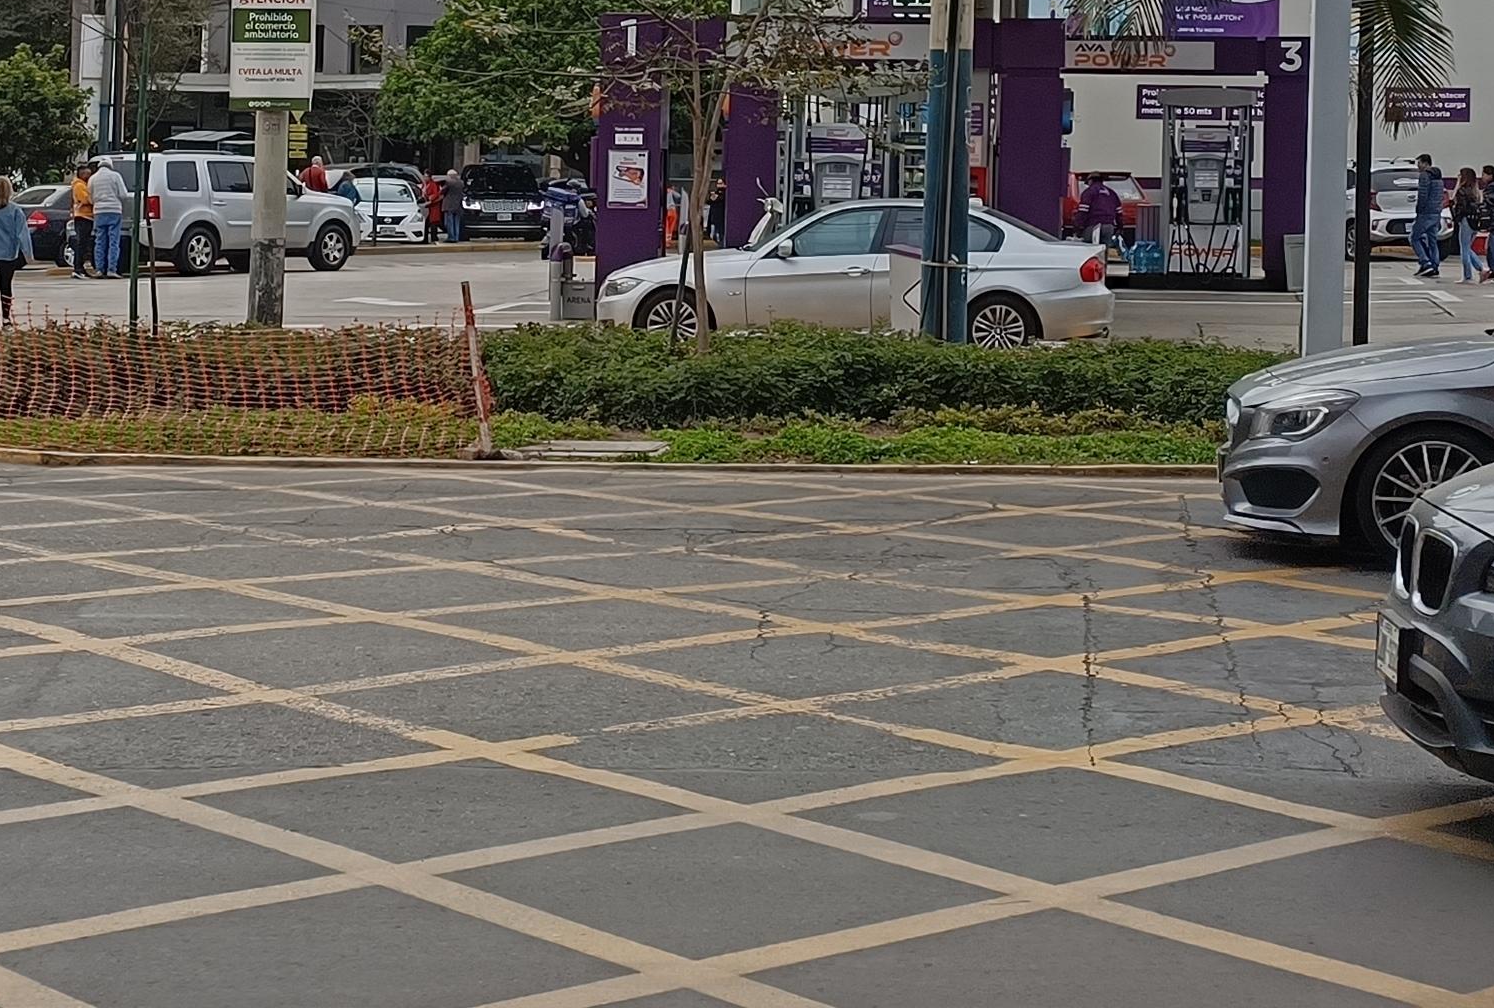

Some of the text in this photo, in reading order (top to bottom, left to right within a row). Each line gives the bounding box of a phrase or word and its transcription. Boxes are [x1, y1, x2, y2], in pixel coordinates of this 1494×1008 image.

[249, 12, 293, 22] Prohibido
[245, 21, 297, 30] el comercio
[244, 30, 299, 39] ambulatorio
[619, 18, 638, 57] 1
[1075, 43, 1105, 52] AVA
[1279, 41, 1303, 73] 3
[274, 68, 303, 76] MULTA
[1184, 107, 1195, 115] 50
